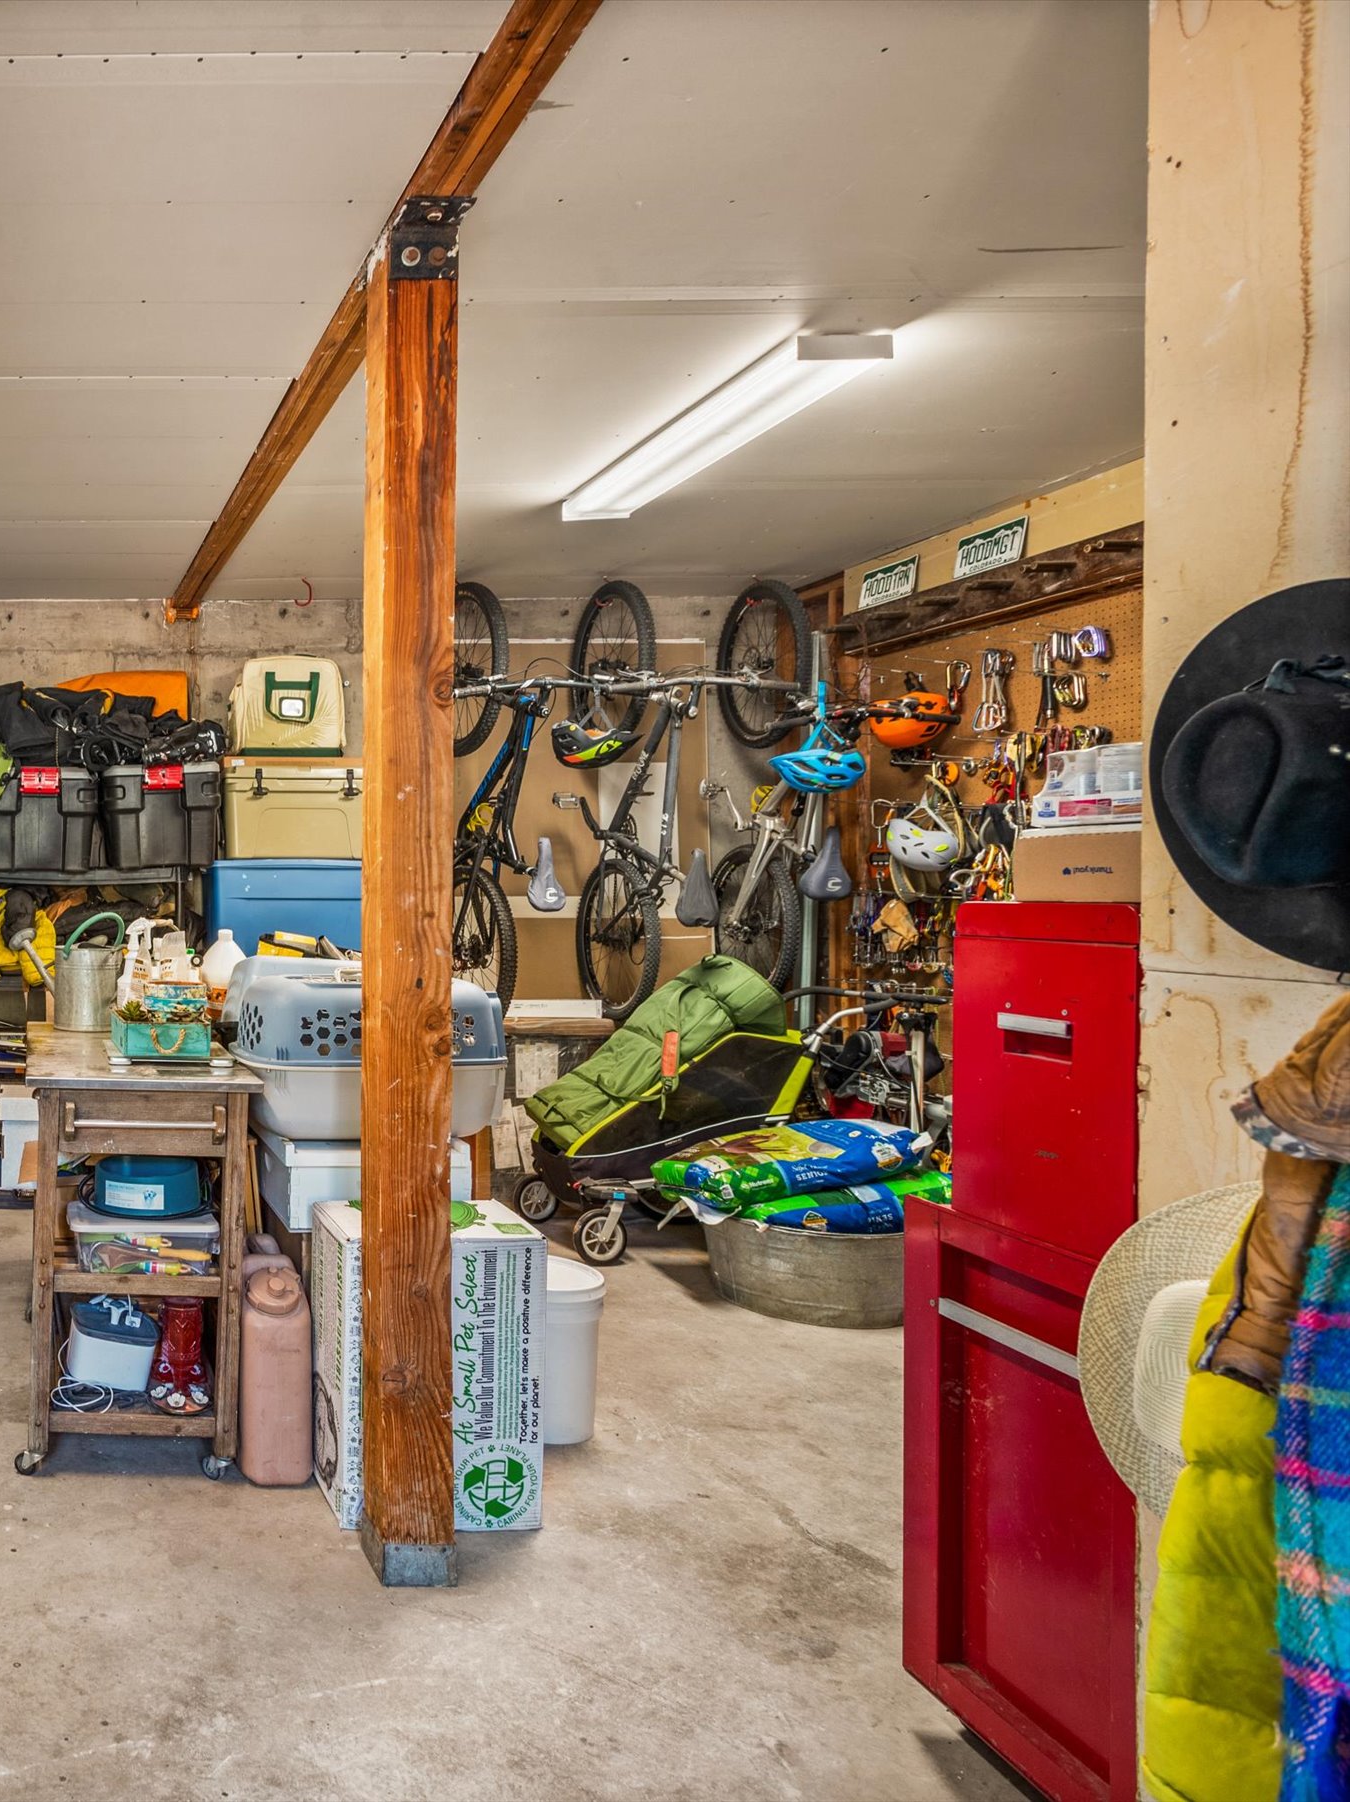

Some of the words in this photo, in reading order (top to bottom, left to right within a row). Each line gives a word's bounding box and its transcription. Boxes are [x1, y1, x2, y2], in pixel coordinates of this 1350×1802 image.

[959, 530, 1019, 568] HOODMGT
[969, 556, 1002, 572] COLORADO
[870, 590, 900, 603] COLORADO
[795, 1170, 828, 1181] SENIO
[478, 1246, 498, 1301] Environment.
[522, 1247, 532, 1294] difference
[477, 1302, 496, 1318] The
[521, 1298, 530, 1334] positive
[477, 1319, 495, 1330] To
[454, 1322, 477, 1352] Pet
[476, 1332, 495, 1384] Commitment
[520, 1348, 529, 1374] make
[452, 1359, 476, 1413] Small
[475, 1386, 494, 1400] Our
[520, 1376, 528, 1394] lets
[530, 1376, 540, 1408] planet.
[474, 1402, 494, 1424] Value
[452, 1421, 474, 1445] At
[474, 1426, 493, 1440] We
[530, 1431, 538, 1444] for
[468, 1446, 484, 1460] PET
[500, 1444, 530, 1464] PLANET
[454, 1458, 470, 1480] YOUR
[526, 1462, 538, 1486] YOUR
[525, 1488, 537, 1508] FOR
[455, 1501, 482, 1526] CARING
[497, 1506, 528, 1528] CARING
